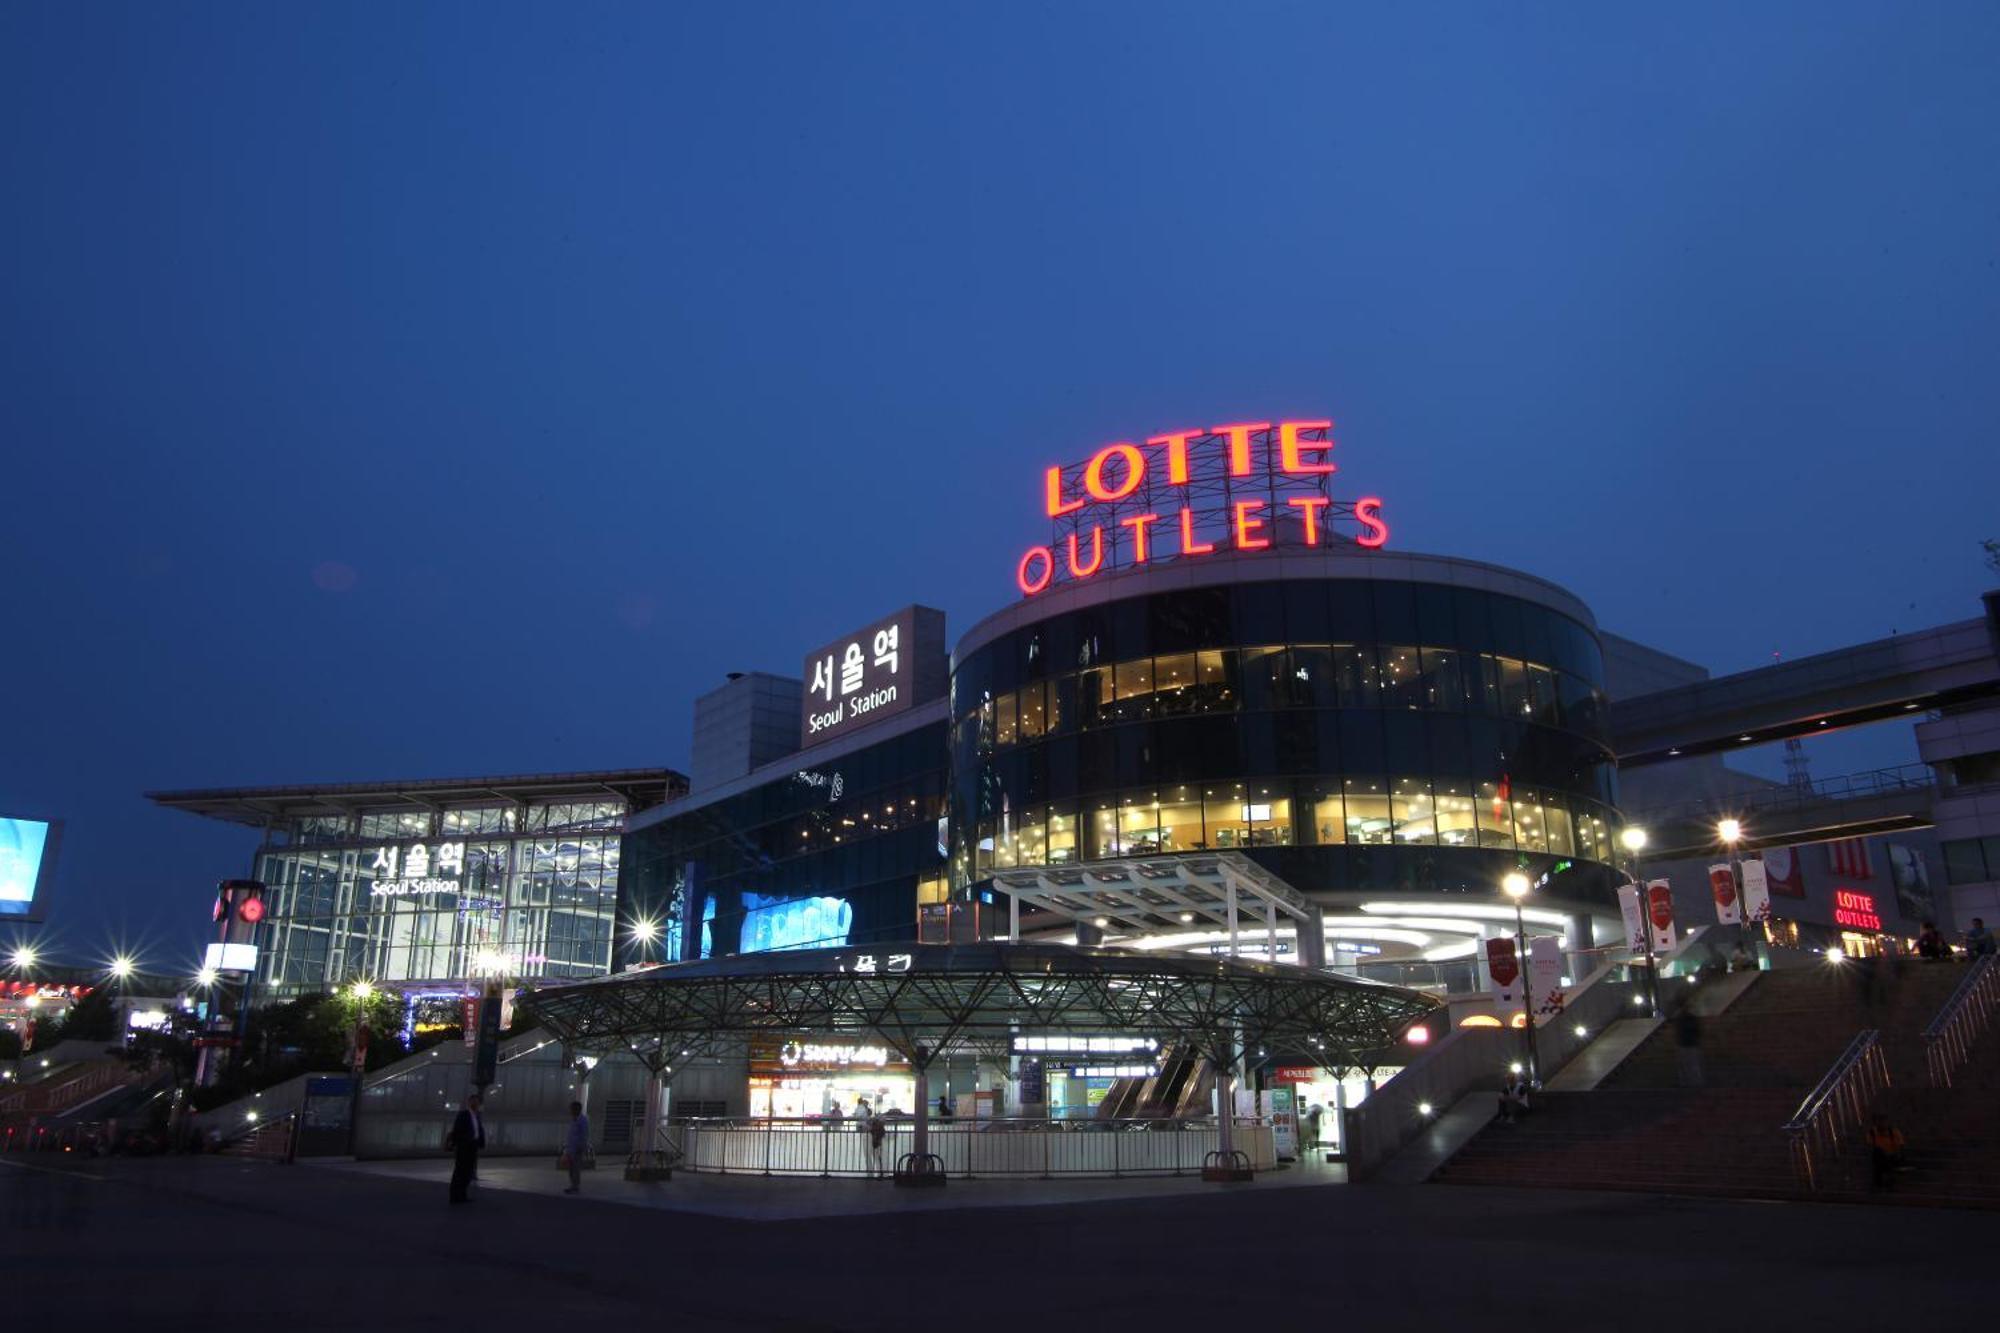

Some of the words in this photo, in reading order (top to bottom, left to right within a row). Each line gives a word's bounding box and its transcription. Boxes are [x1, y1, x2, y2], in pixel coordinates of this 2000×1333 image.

[1046, 420, 1335, 517] LOTTE
[1018, 497, 1388, 594] OUTLETS
[810, 625, 899, 701] 서울역
[809, 702, 843, 733] Seoul
[850, 686, 897, 717] Station
[373, 843, 464, 878] 서울역
[370, 880, 409, 895] Seoul
[411, 879, 459, 894] Station
[1837, 891, 1873, 912] LOTTE
[1836, 909, 1880, 930] OUTLETS
